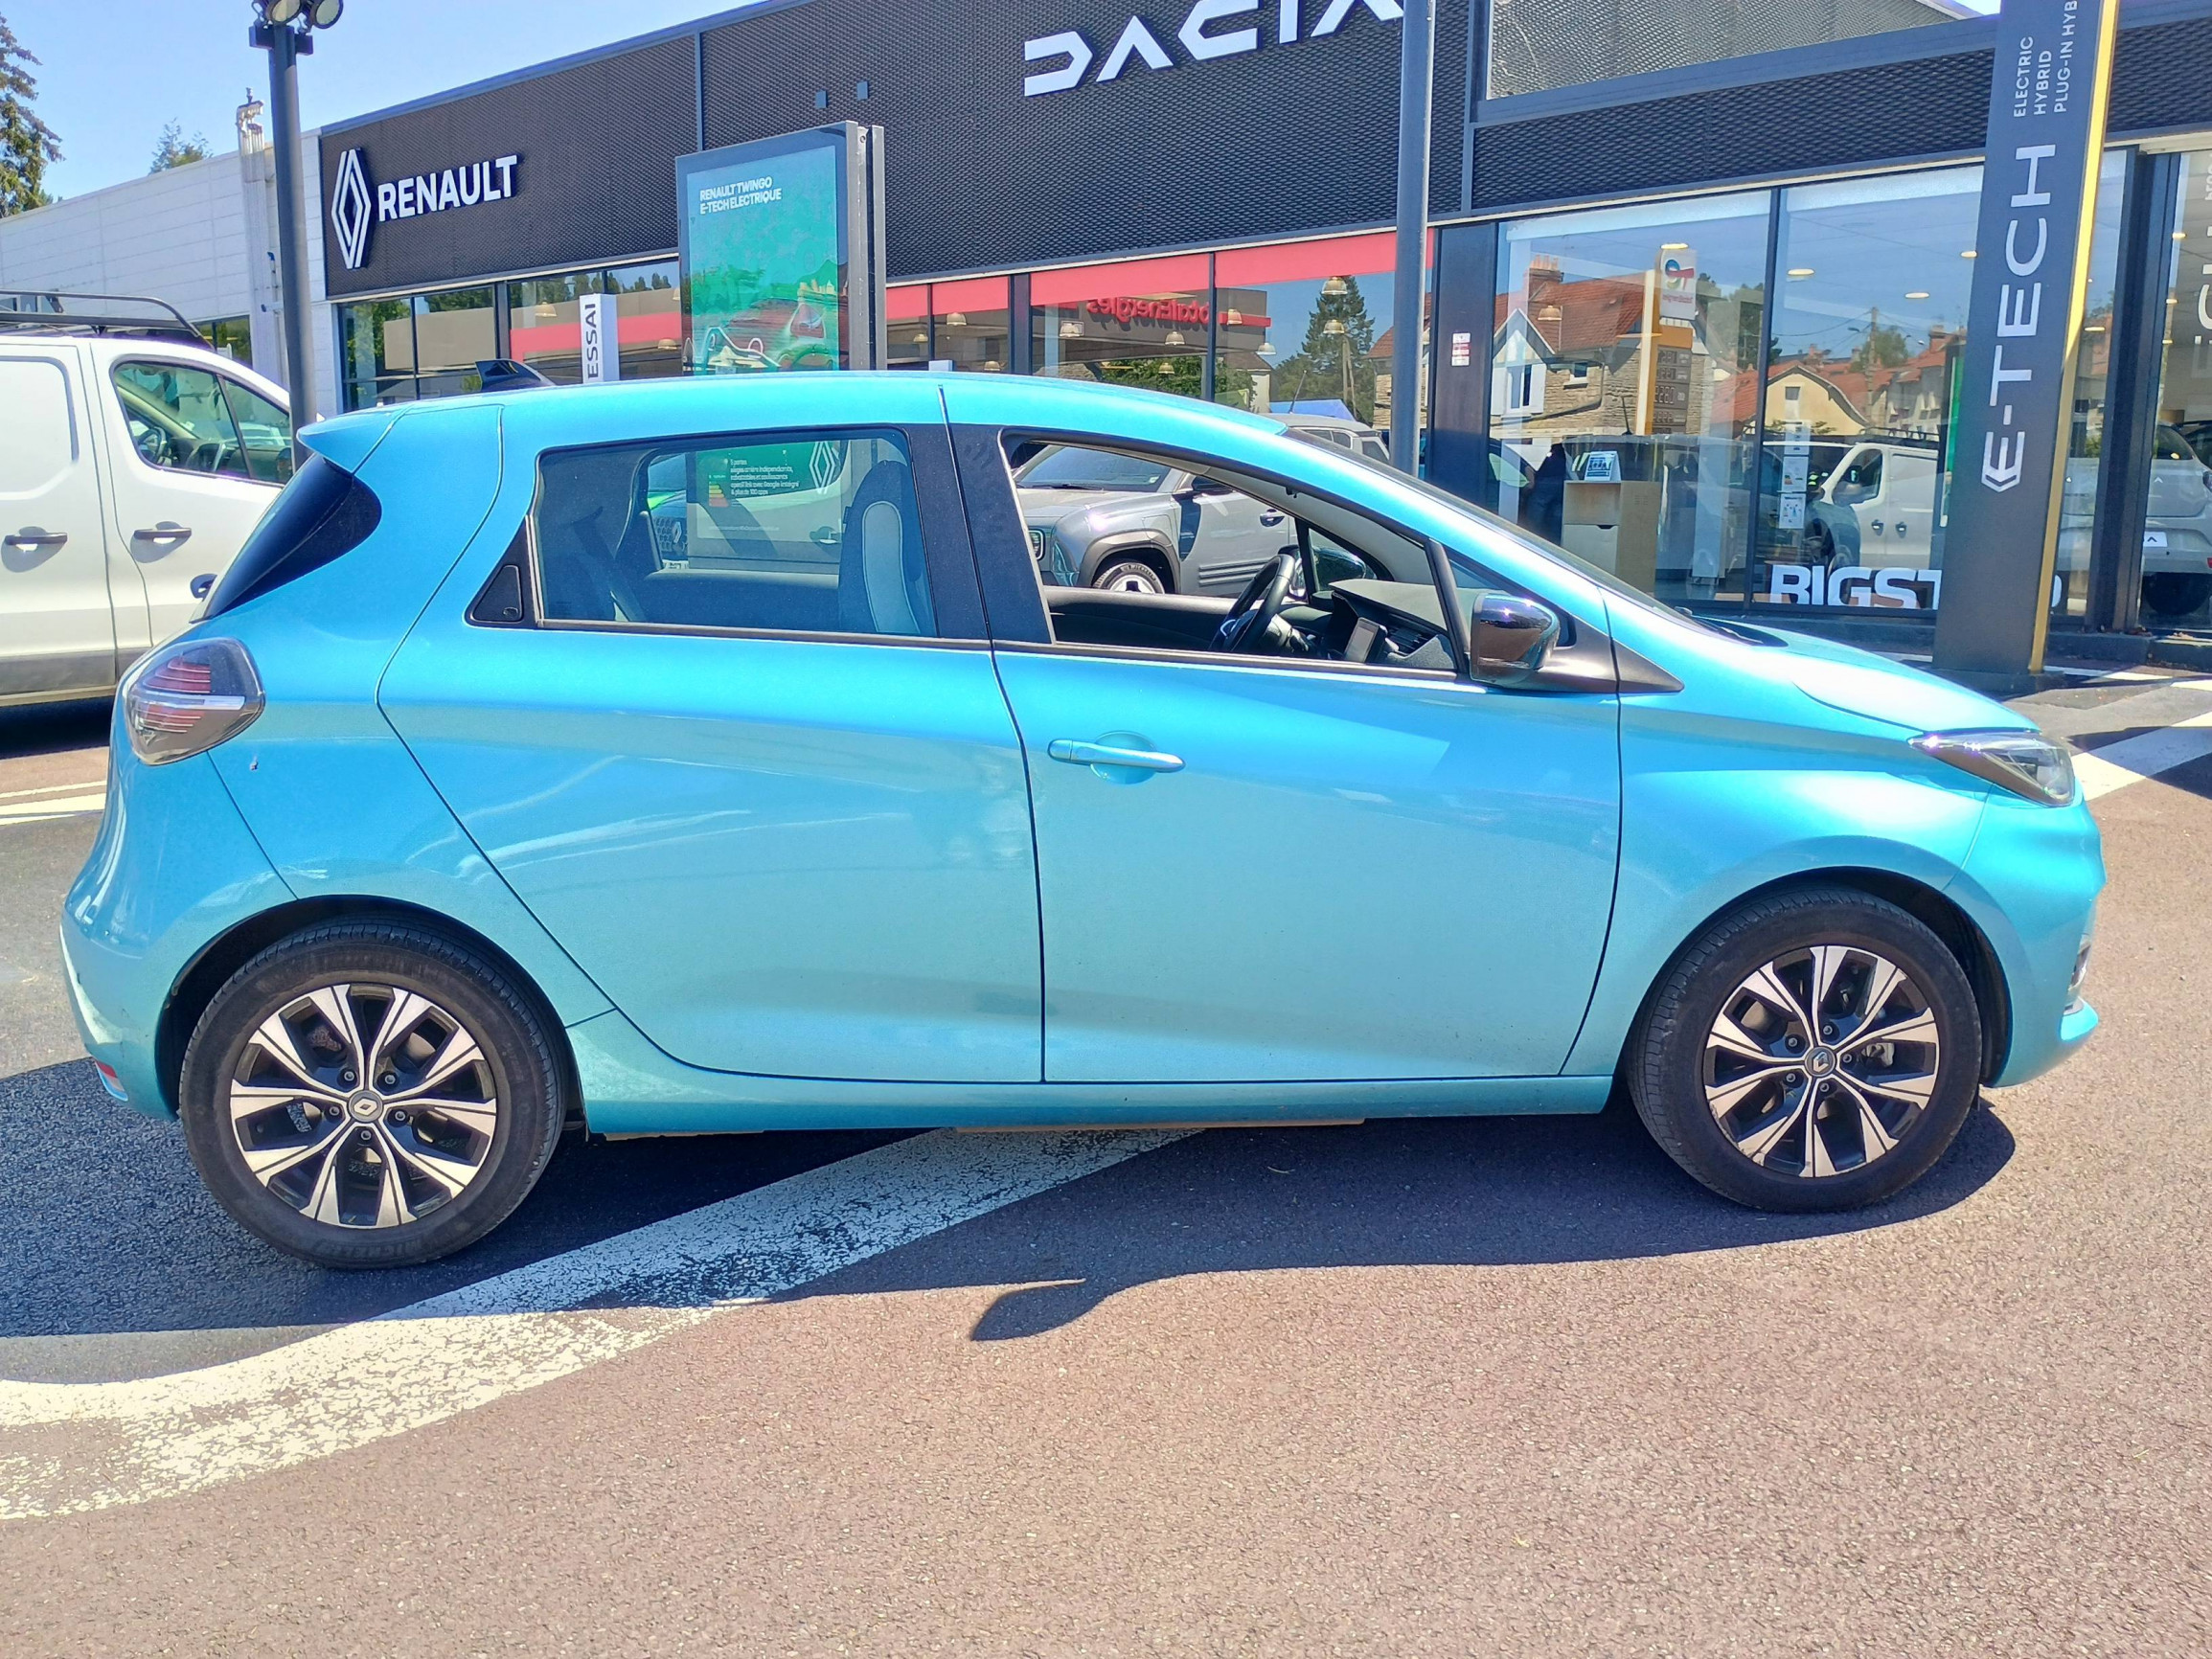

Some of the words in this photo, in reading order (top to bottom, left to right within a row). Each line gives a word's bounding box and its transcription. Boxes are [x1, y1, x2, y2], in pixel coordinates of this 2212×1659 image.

[2014, 36, 2034, 117] ELECTRIC
[2033, 50, 2052, 115] HYBRID
[2053, 40, 2074, 113] PLUG-IN
[377, 154, 517, 222] RENAULT
[699, 184, 736, 202] RENAULT
[736, 176, 773, 194] TWINGO
[699, 196, 730, 215] E-TECH
[730, 188, 783, 210] ELECTRIQUE
[584, 303, 599, 379] ESSAI
[1981, 144, 2057, 492] E-TECH
